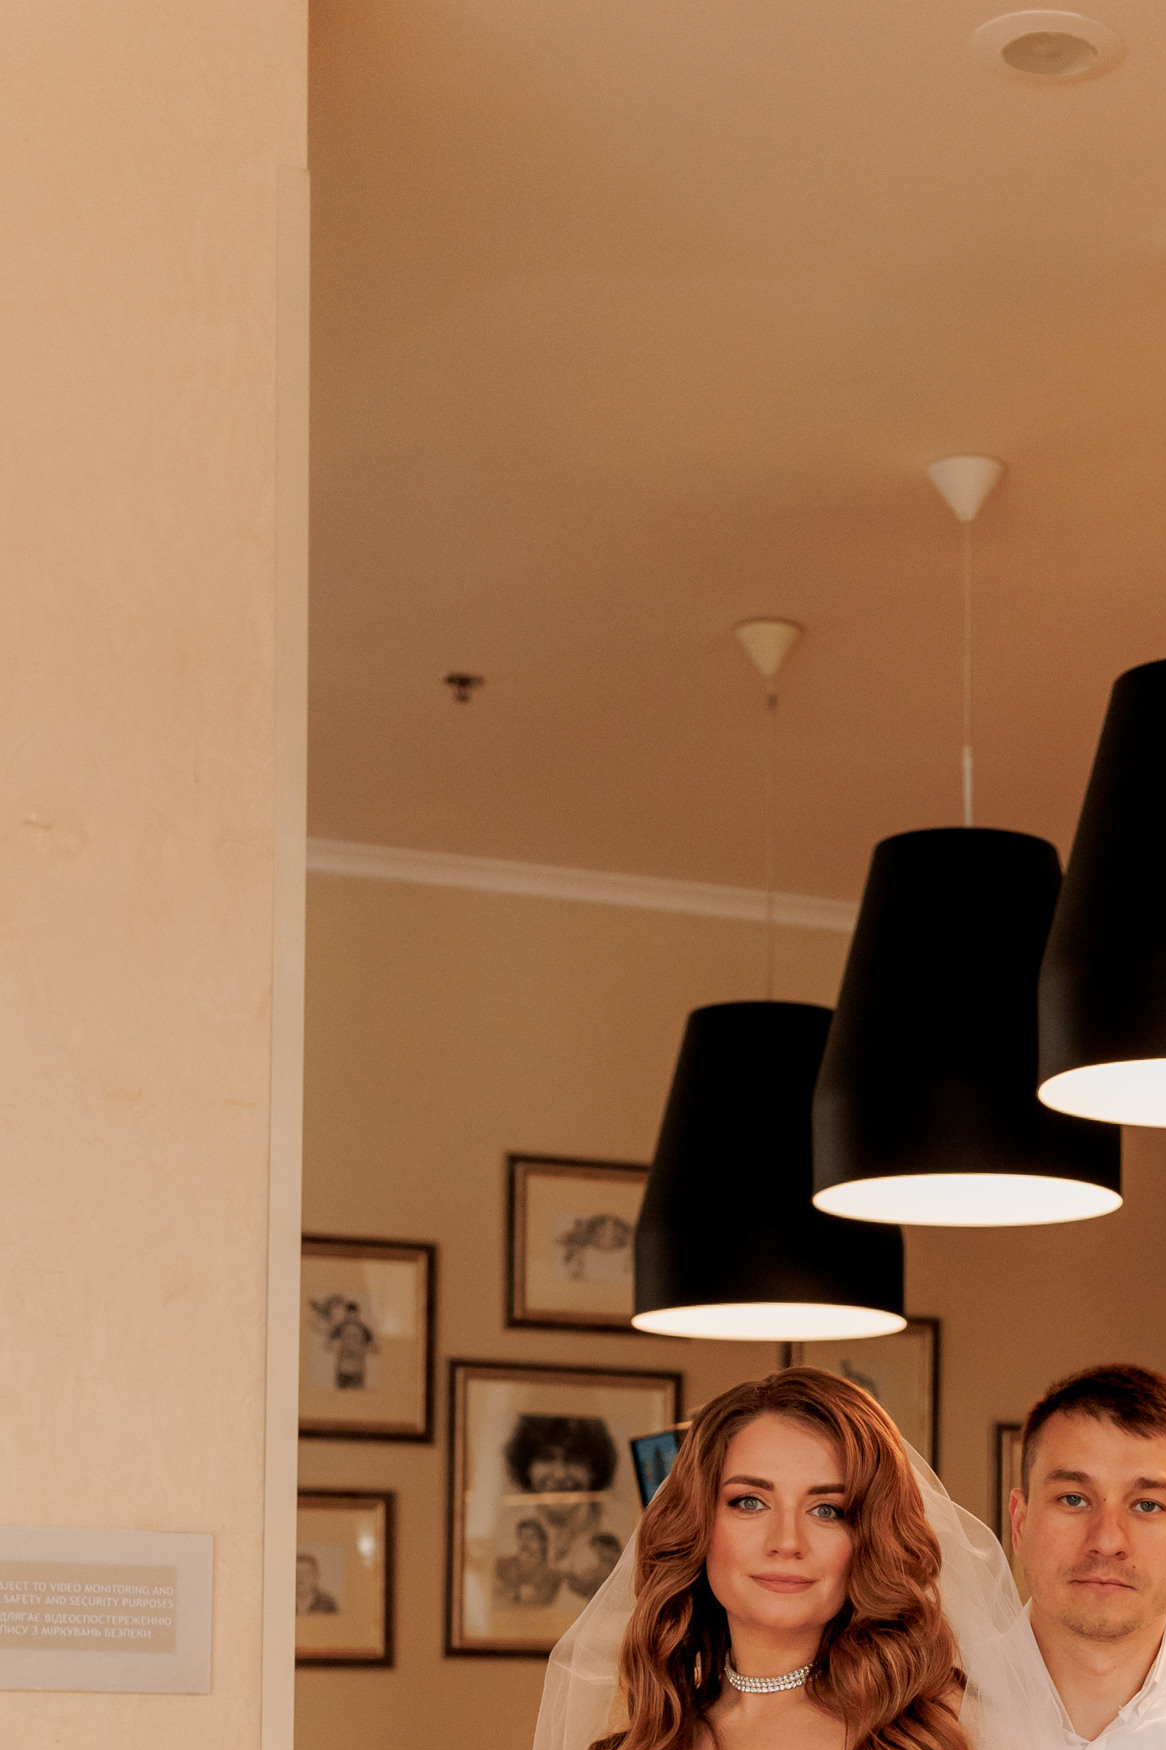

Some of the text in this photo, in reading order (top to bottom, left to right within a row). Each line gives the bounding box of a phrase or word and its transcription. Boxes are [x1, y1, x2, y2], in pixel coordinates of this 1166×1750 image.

[32, 1581, 46, 1591] TO
[49, 1582, 81, 1592] VIDEO
[84, 1584, 149, 1595] MONITORING
[152, 1586, 173, 1596] AND
[3, 1593, 173, 1609] SAFETY AND SECURITY PURPOSES
[42, 1626, 101, 1637] МІРКУВАНЬ
[105, 1628, 151, 1638] БЕЗПЕКИ
